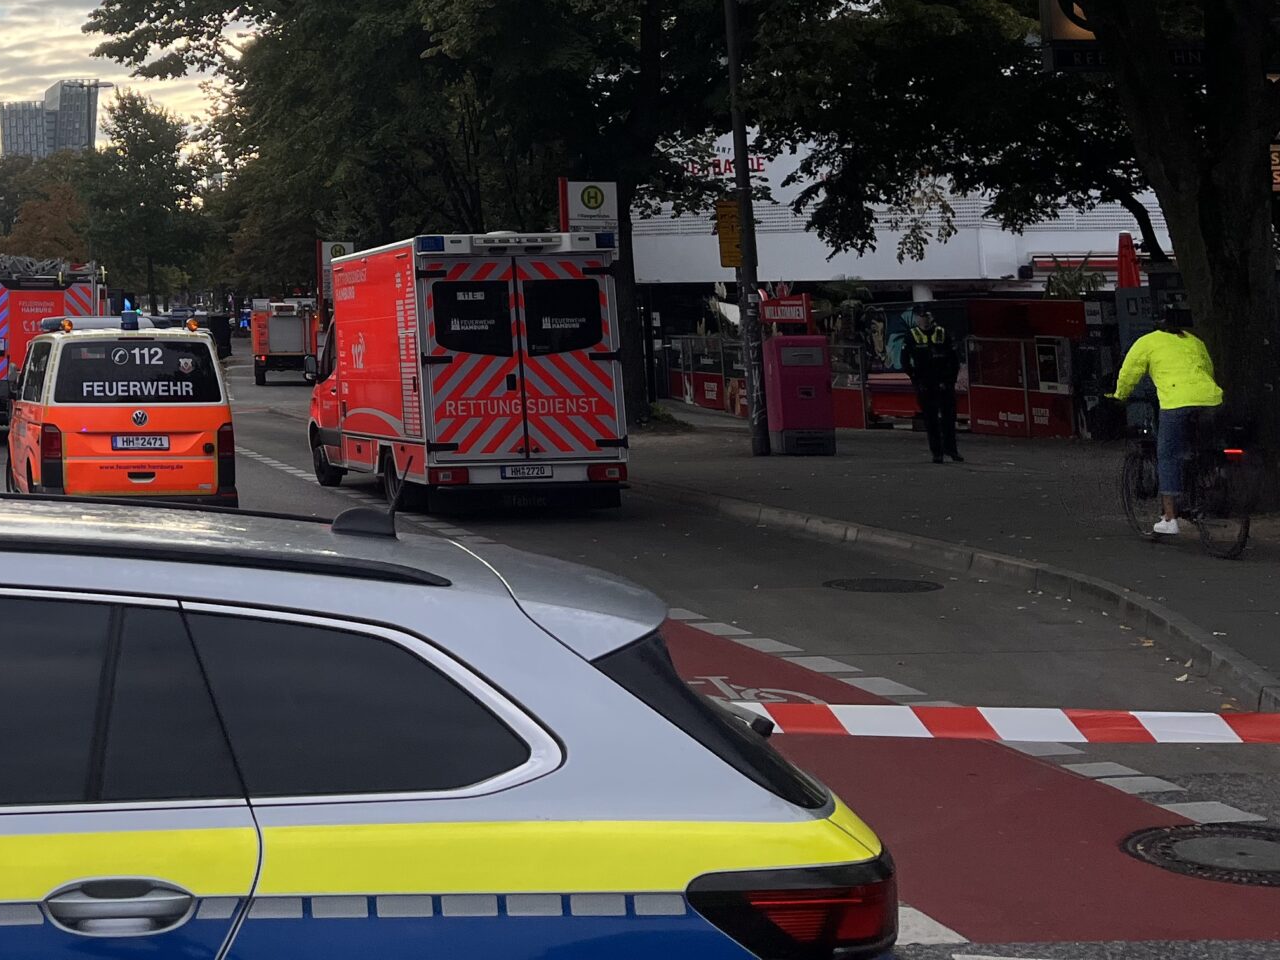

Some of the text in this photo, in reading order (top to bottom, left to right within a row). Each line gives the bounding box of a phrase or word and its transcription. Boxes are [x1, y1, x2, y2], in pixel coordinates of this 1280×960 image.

[130, 347, 164, 365] 112
[351, 343, 364, 369] 112
[82, 381, 194, 396] FEUERWEHR
[445, 398, 599, 416] RETTUNGSDIENST
[121, 437, 164, 447] HH 2471
[511, 466, 545, 476] HH 2720
